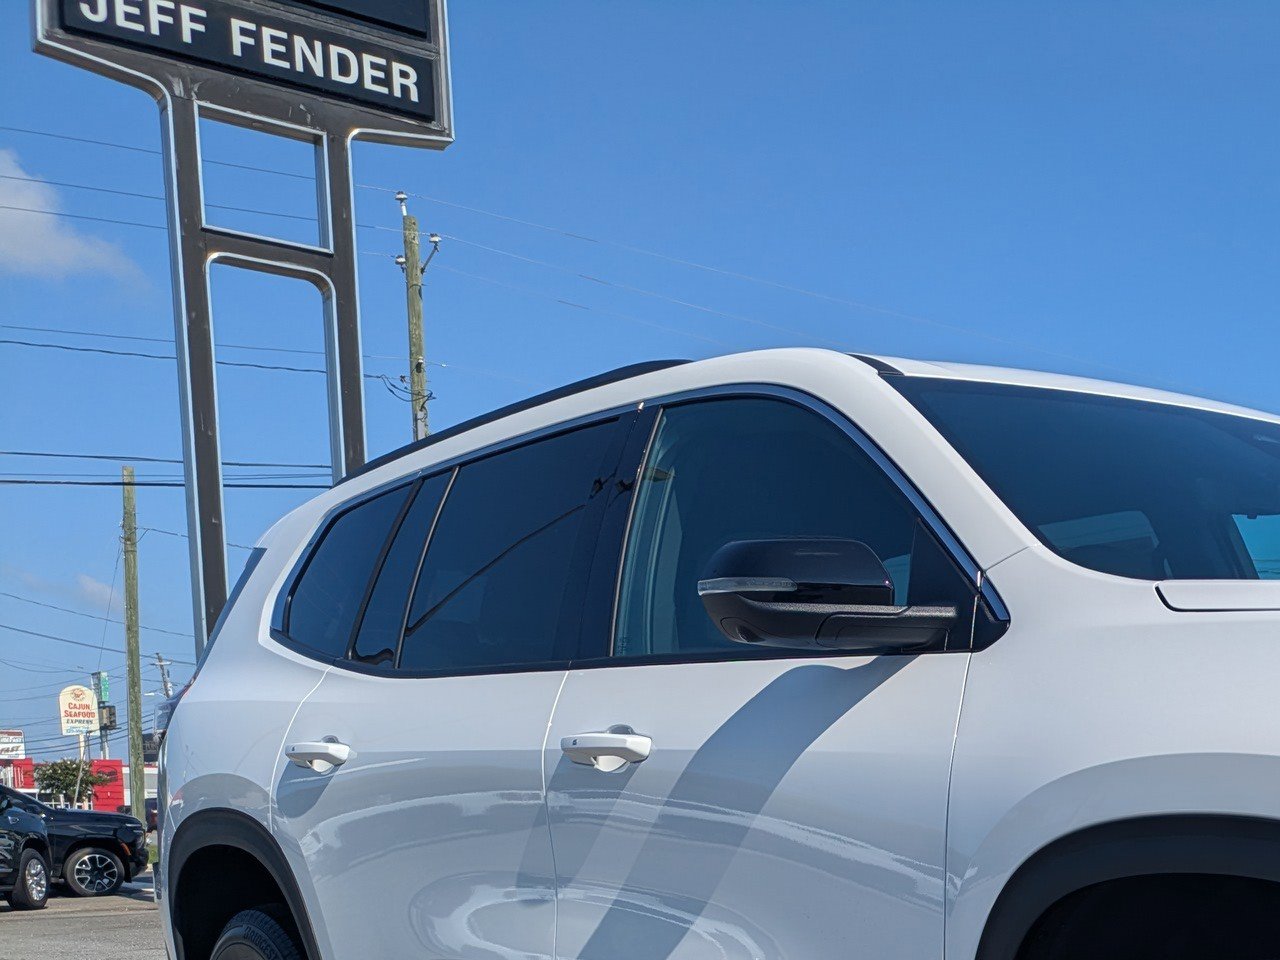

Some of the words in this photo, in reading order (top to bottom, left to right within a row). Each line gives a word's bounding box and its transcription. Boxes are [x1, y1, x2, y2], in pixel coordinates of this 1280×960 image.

[79, 0, 207, 44] JEFF
[230, 18, 419, 103] FENDER
[68, 702, 91, 710] CAJUN
[64, 710, 96, 718] SEAFOOD
